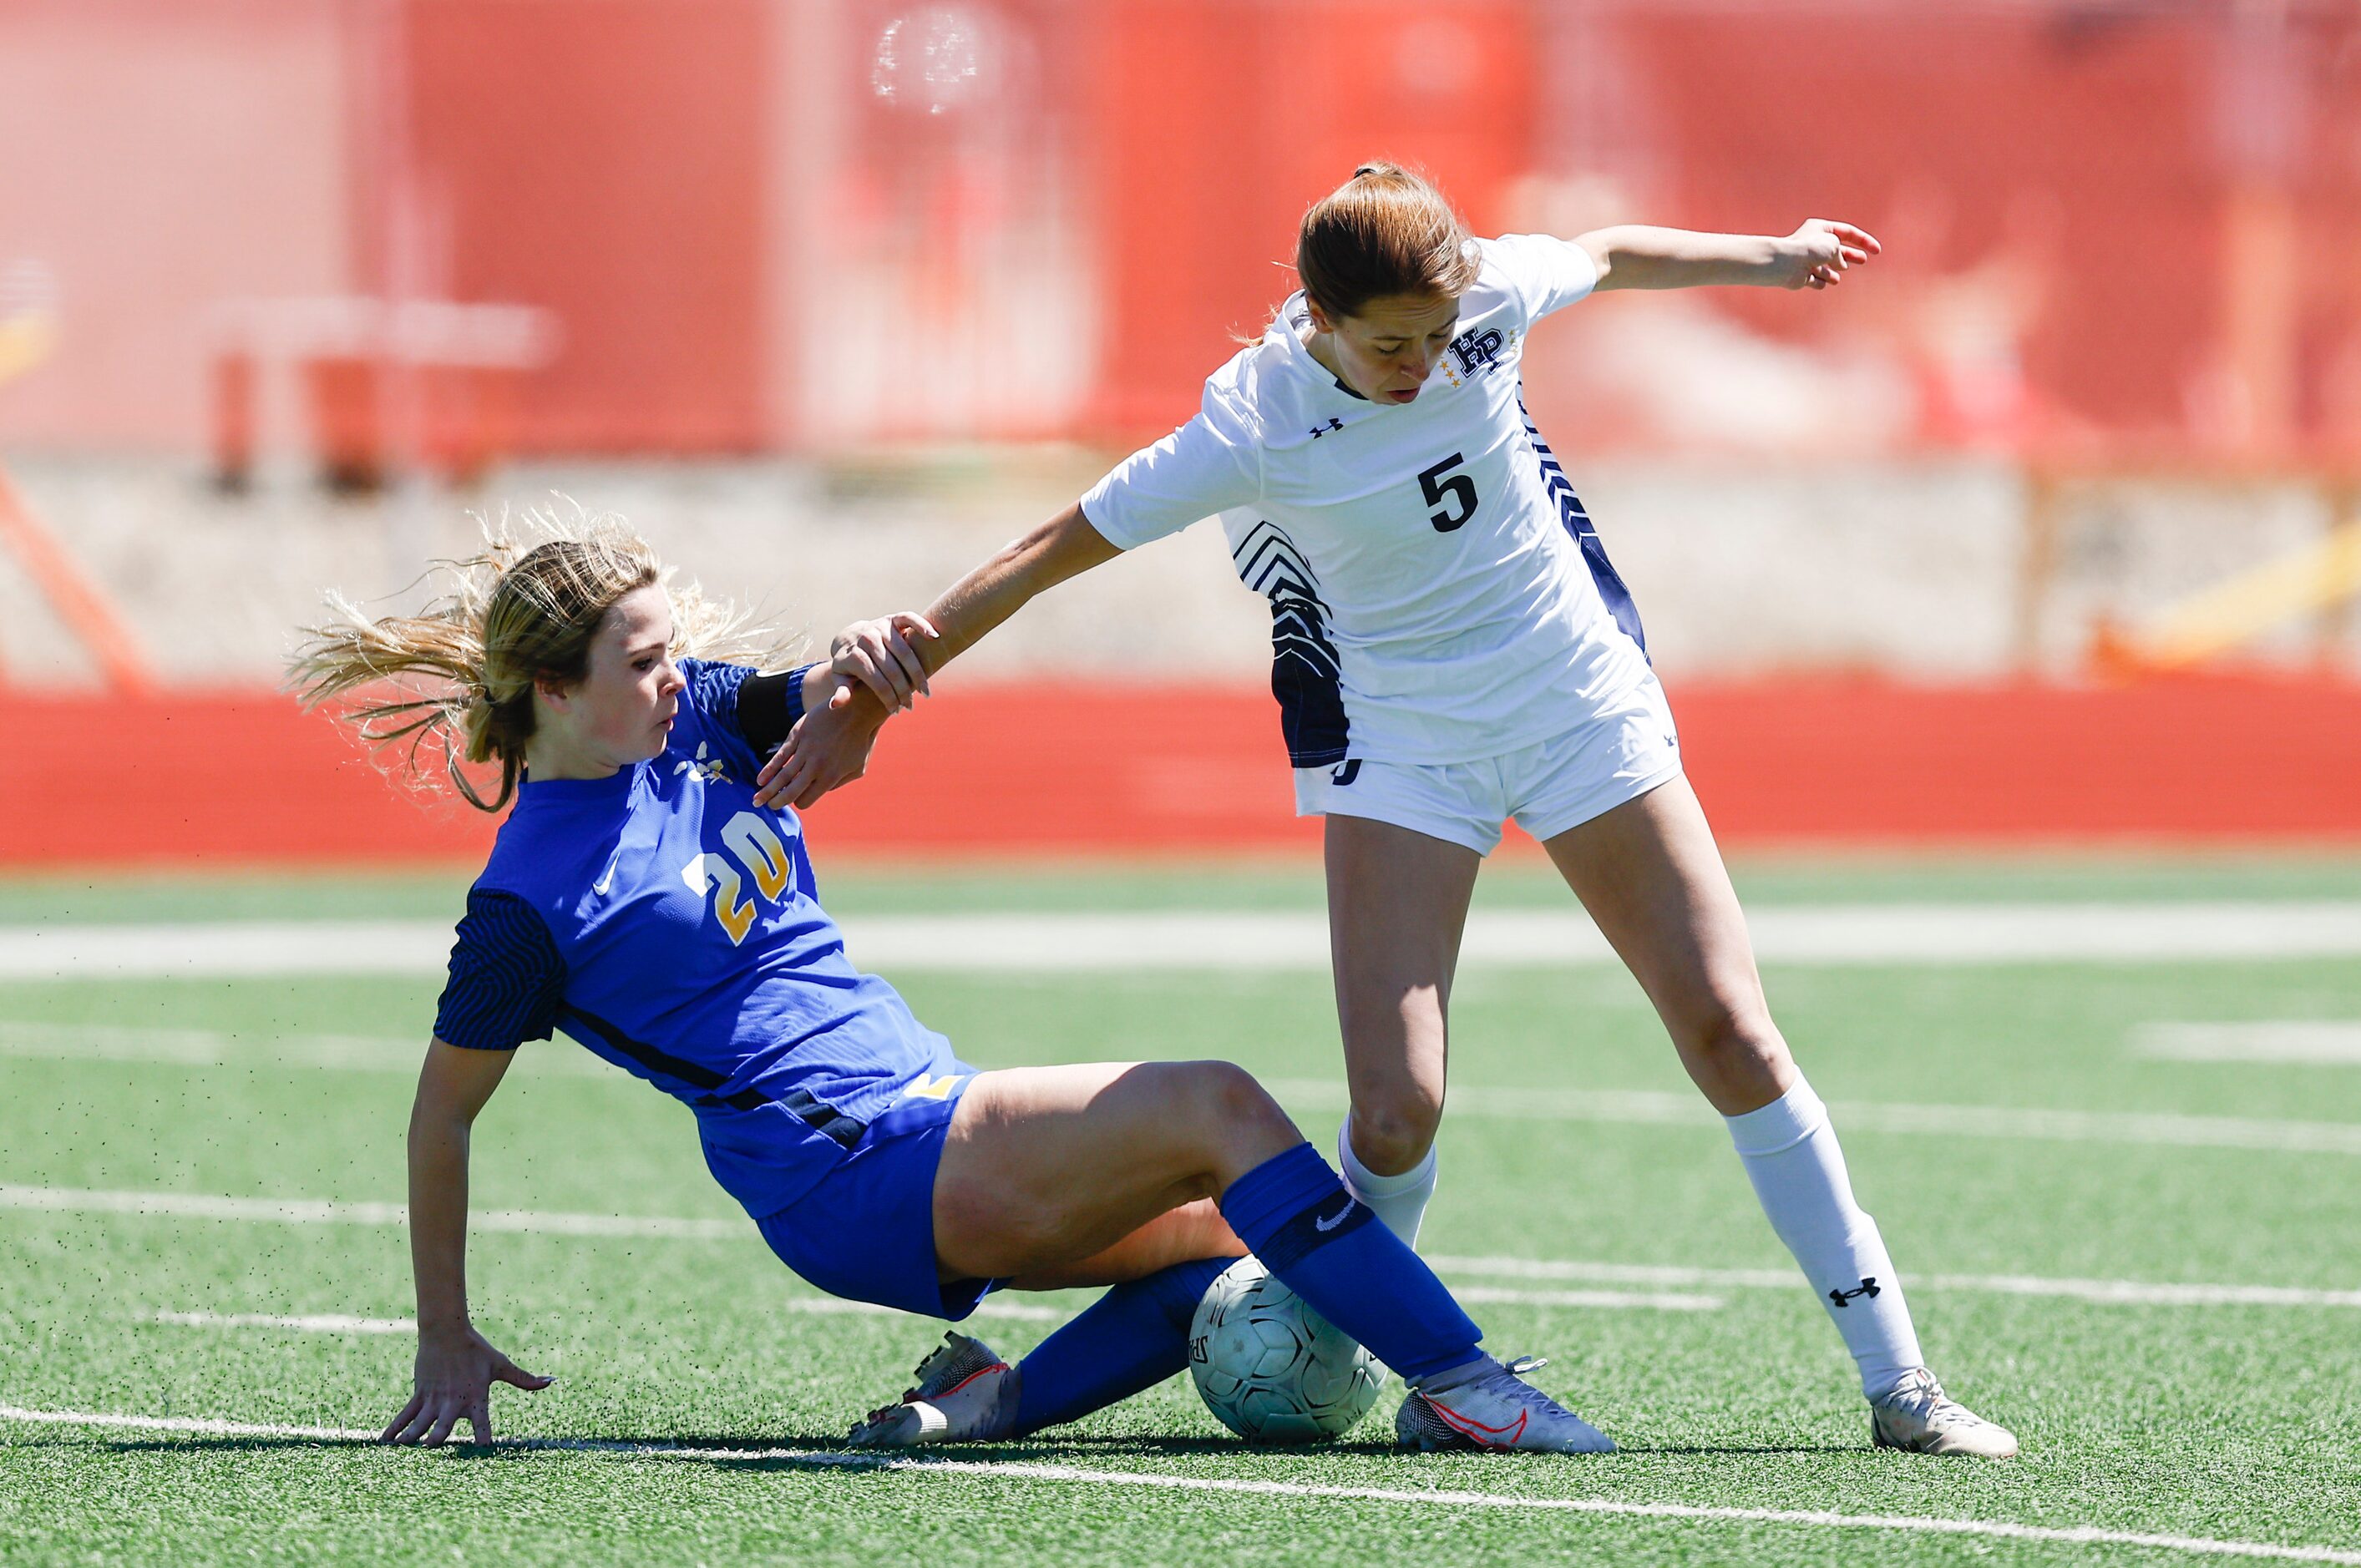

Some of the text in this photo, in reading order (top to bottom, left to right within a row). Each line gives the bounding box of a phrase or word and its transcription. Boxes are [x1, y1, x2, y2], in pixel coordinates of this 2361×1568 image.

[1447, 326, 1504, 378] HP
[1417, 452, 1478, 533] 5
[681, 811, 789, 948] 20
